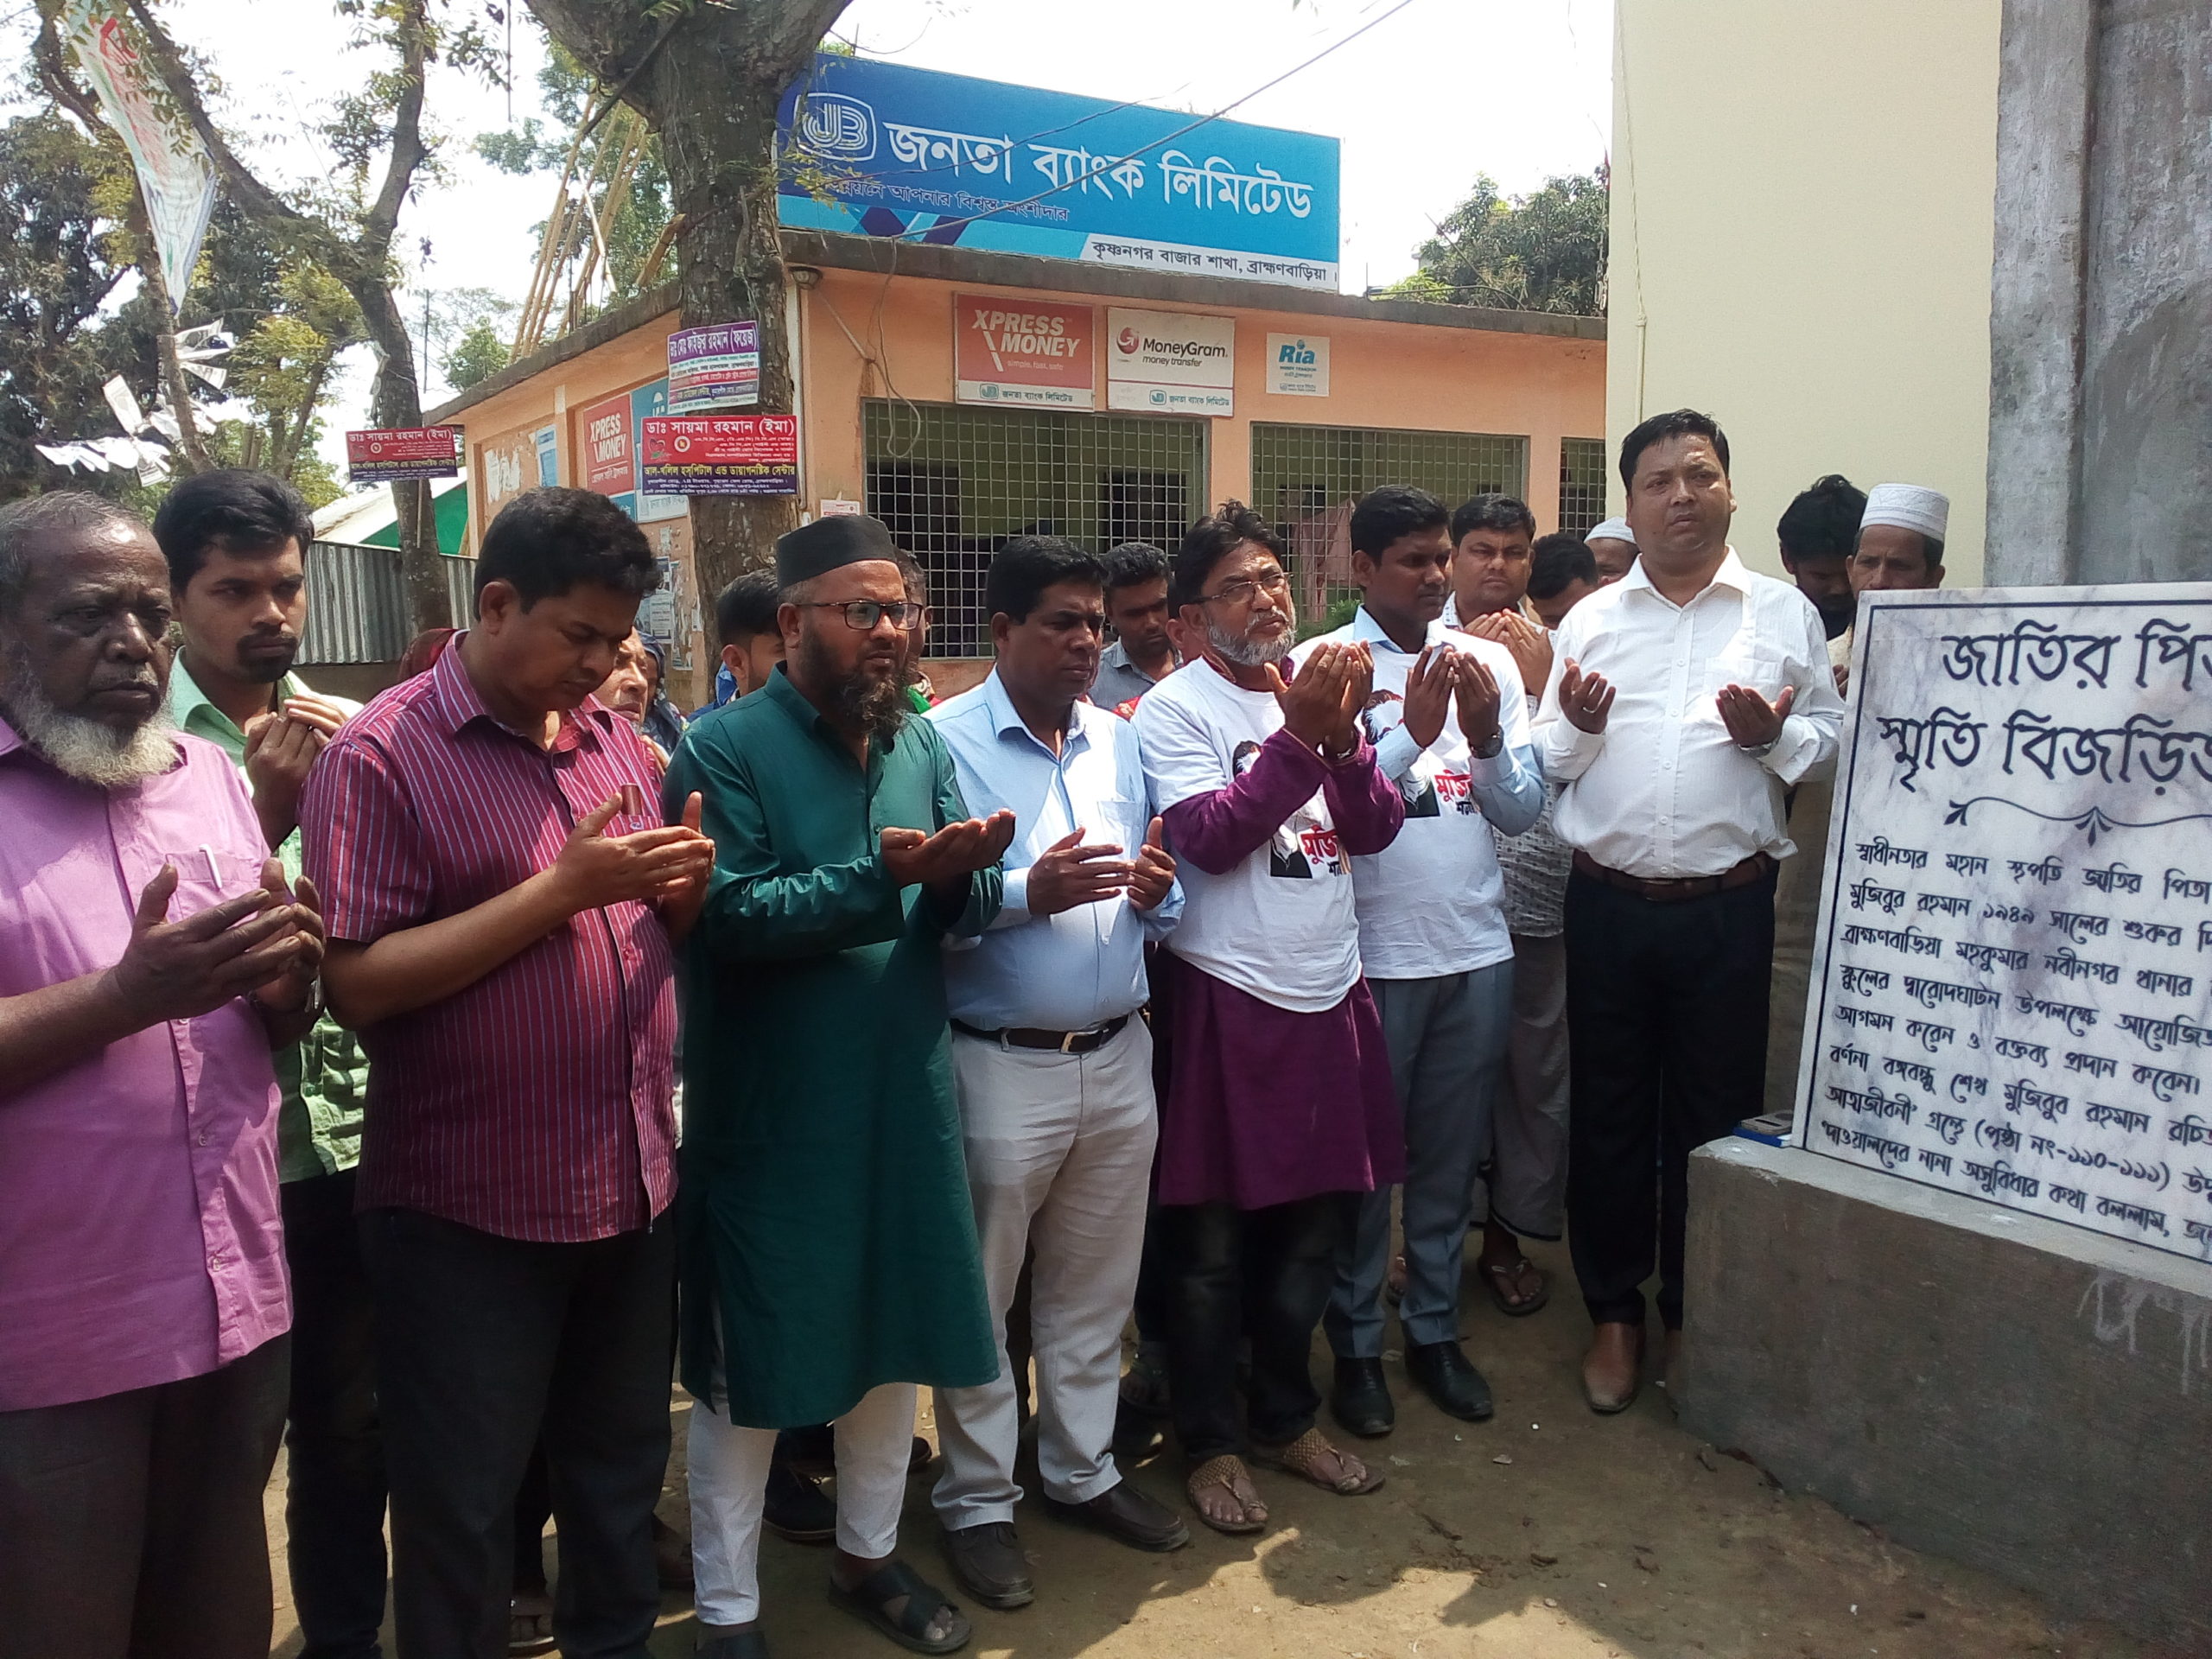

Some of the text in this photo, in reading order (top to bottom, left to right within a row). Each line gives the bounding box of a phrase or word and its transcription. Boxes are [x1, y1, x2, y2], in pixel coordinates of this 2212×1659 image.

[882, 122, 1313, 219] জনতা ব্যাংক লিমিটেড
[887, 185, 952, 207] আপনার
[1091, 241, 1154, 260] কৃষ্ণনগর
[1159, 249, 1202, 267] বাজার
[1206, 255, 1243, 274] শাখা,
[1247, 260, 1327, 282] ব্রাহ্মণবাড়িয়া
[972, 309, 1065, 336] XPRESS
[1001, 333, 1080, 358] MONEY
[1142, 355, 1203, 367] money transfer
[1279, 339, 1315, 365] Ria
[1002, 391, 1022, 400] জনতা
[366, 432, 393, 442] সায়মা
[397, 430, 423, 441] রহমান
[589, 413, 621, 443] XPRESS
[646, 418, 794, 436] ডাঃ সায়মা রহমান (ইমা)
[598, 433, 627, 461] MONEY
[1942, 619, 2212, 690] জাতির পি
[1877, 707, 1987, 792] স্মৃতি
[1855, 836, 1929, 869] স্বাধীনতার
[1946, 854, 1989, 877] মহান
[2163, 868, 2212, 905] পিতা
[1850, 878, 1905, 916] মুজিবুর
[1917, 893, 1972, 918] রহমান
[2049, 910, 2109, 945] সালের
[1840, 925, 2193, 997] ব্রাহ্মণবাড়িয়া মহকুমার নবীনগর থানার
[1840, 964, 1891, 997] স্কুলের
[1835, 1006, 1895, 1032] আগমন
[1906, 1019, 1956, 1053] করেন
[1967, 1033, 1980, 1049] ও
[1995, 1037, 2050, 1068] বক্তব্য
[2063, 1052, 2119, 1078] প্রদান
[1830, 1043, 1870, 1072] বর্ণনা
[1882, 1057, 1936, 1095] বঙ্গবন্ধু
[1950, 1073, 1988, 1103] শেখ
[2086, 1102, 2152, 1133] রহমান
[1918, 1148, 1953, 1176] নানা
[1961, 1160, 2040, 1198] অসুবিধার
[2049, 1183, 2089, 1214] কথা
[2096, 1196, 2171, 1237] বললাম,
